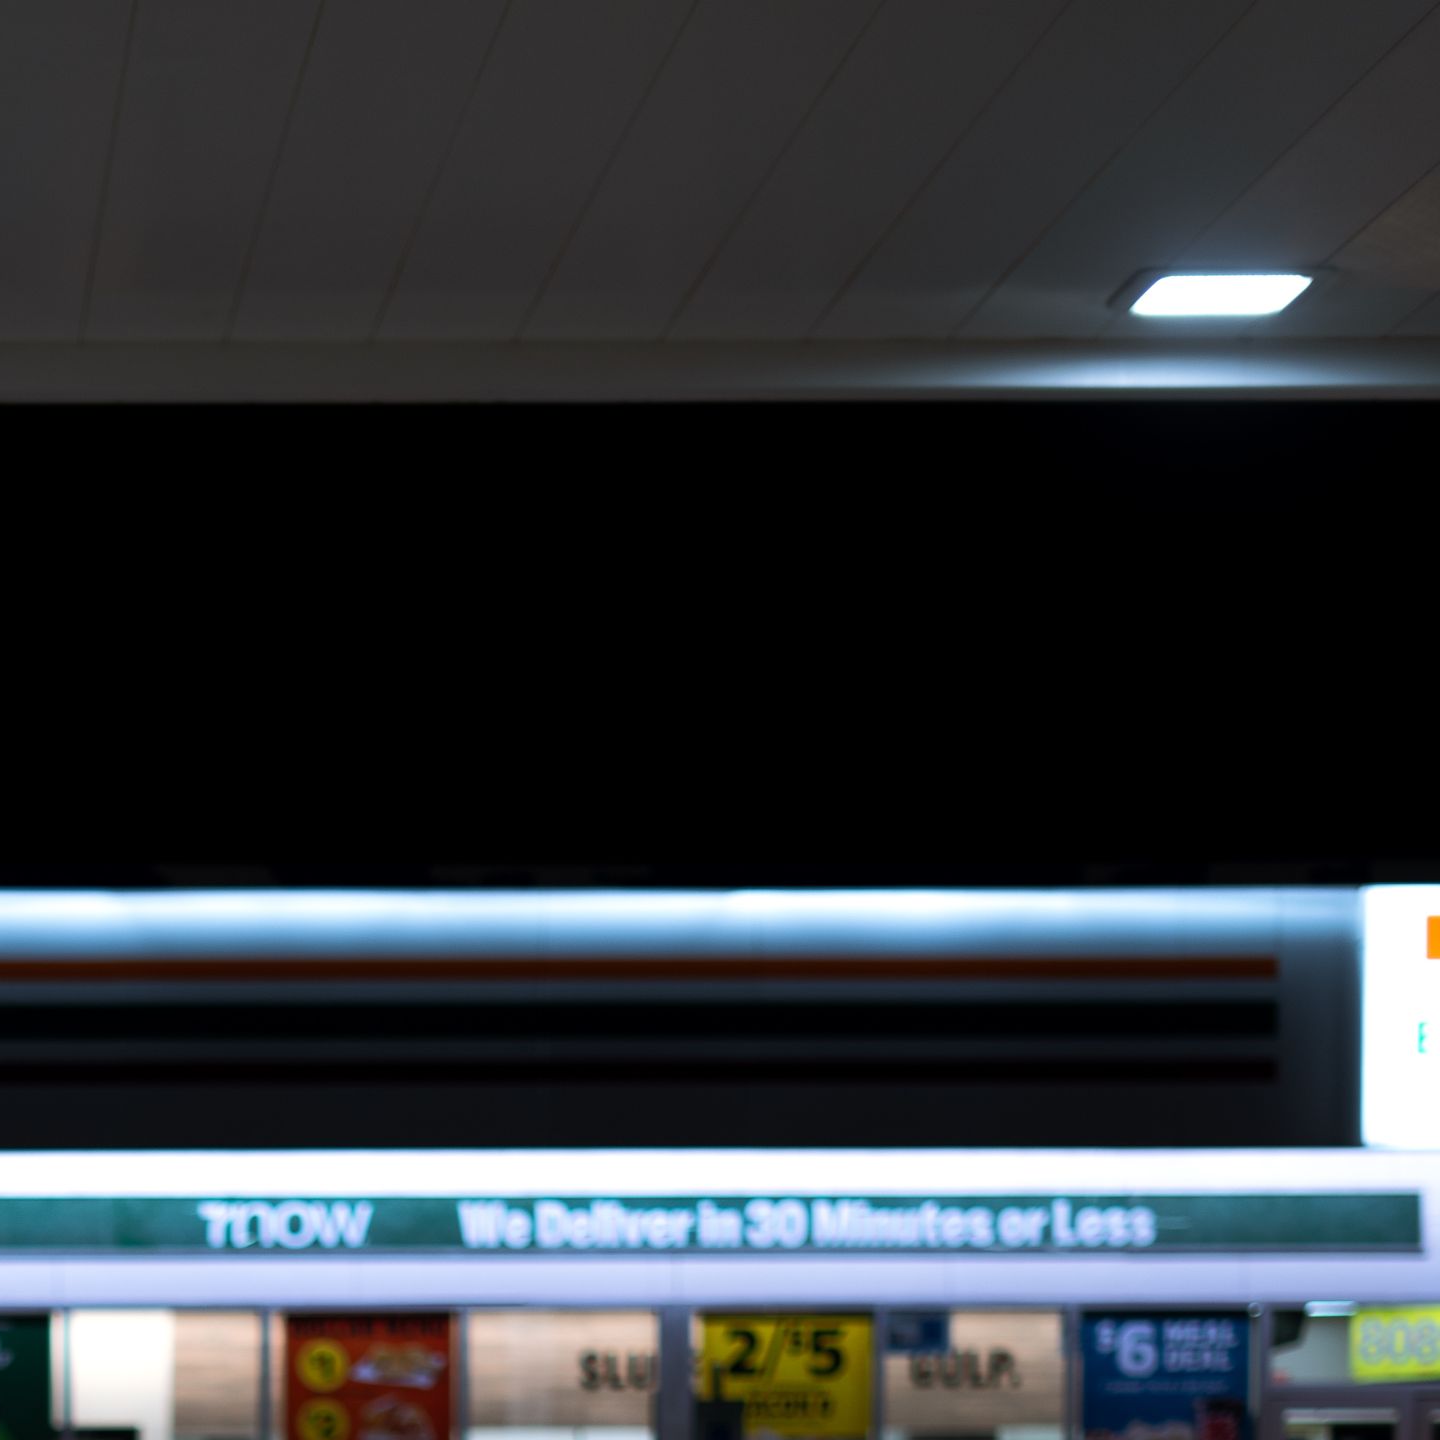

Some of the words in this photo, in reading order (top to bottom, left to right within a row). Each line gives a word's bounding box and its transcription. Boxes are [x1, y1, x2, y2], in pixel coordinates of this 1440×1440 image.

[456, 1199, 532, 1249] We
[533, 1199, 694, 1249] Deliver
[696, 1199, 743, 1248] in
[744, 1199, 808, 1249] 30
[811, 1199, 996, 1249] Minutes
[997, 1205, 1049, 1249] or
[1050, 1197, 1157, 1249] Less
[579, 1349, 658, 1390] SLU
